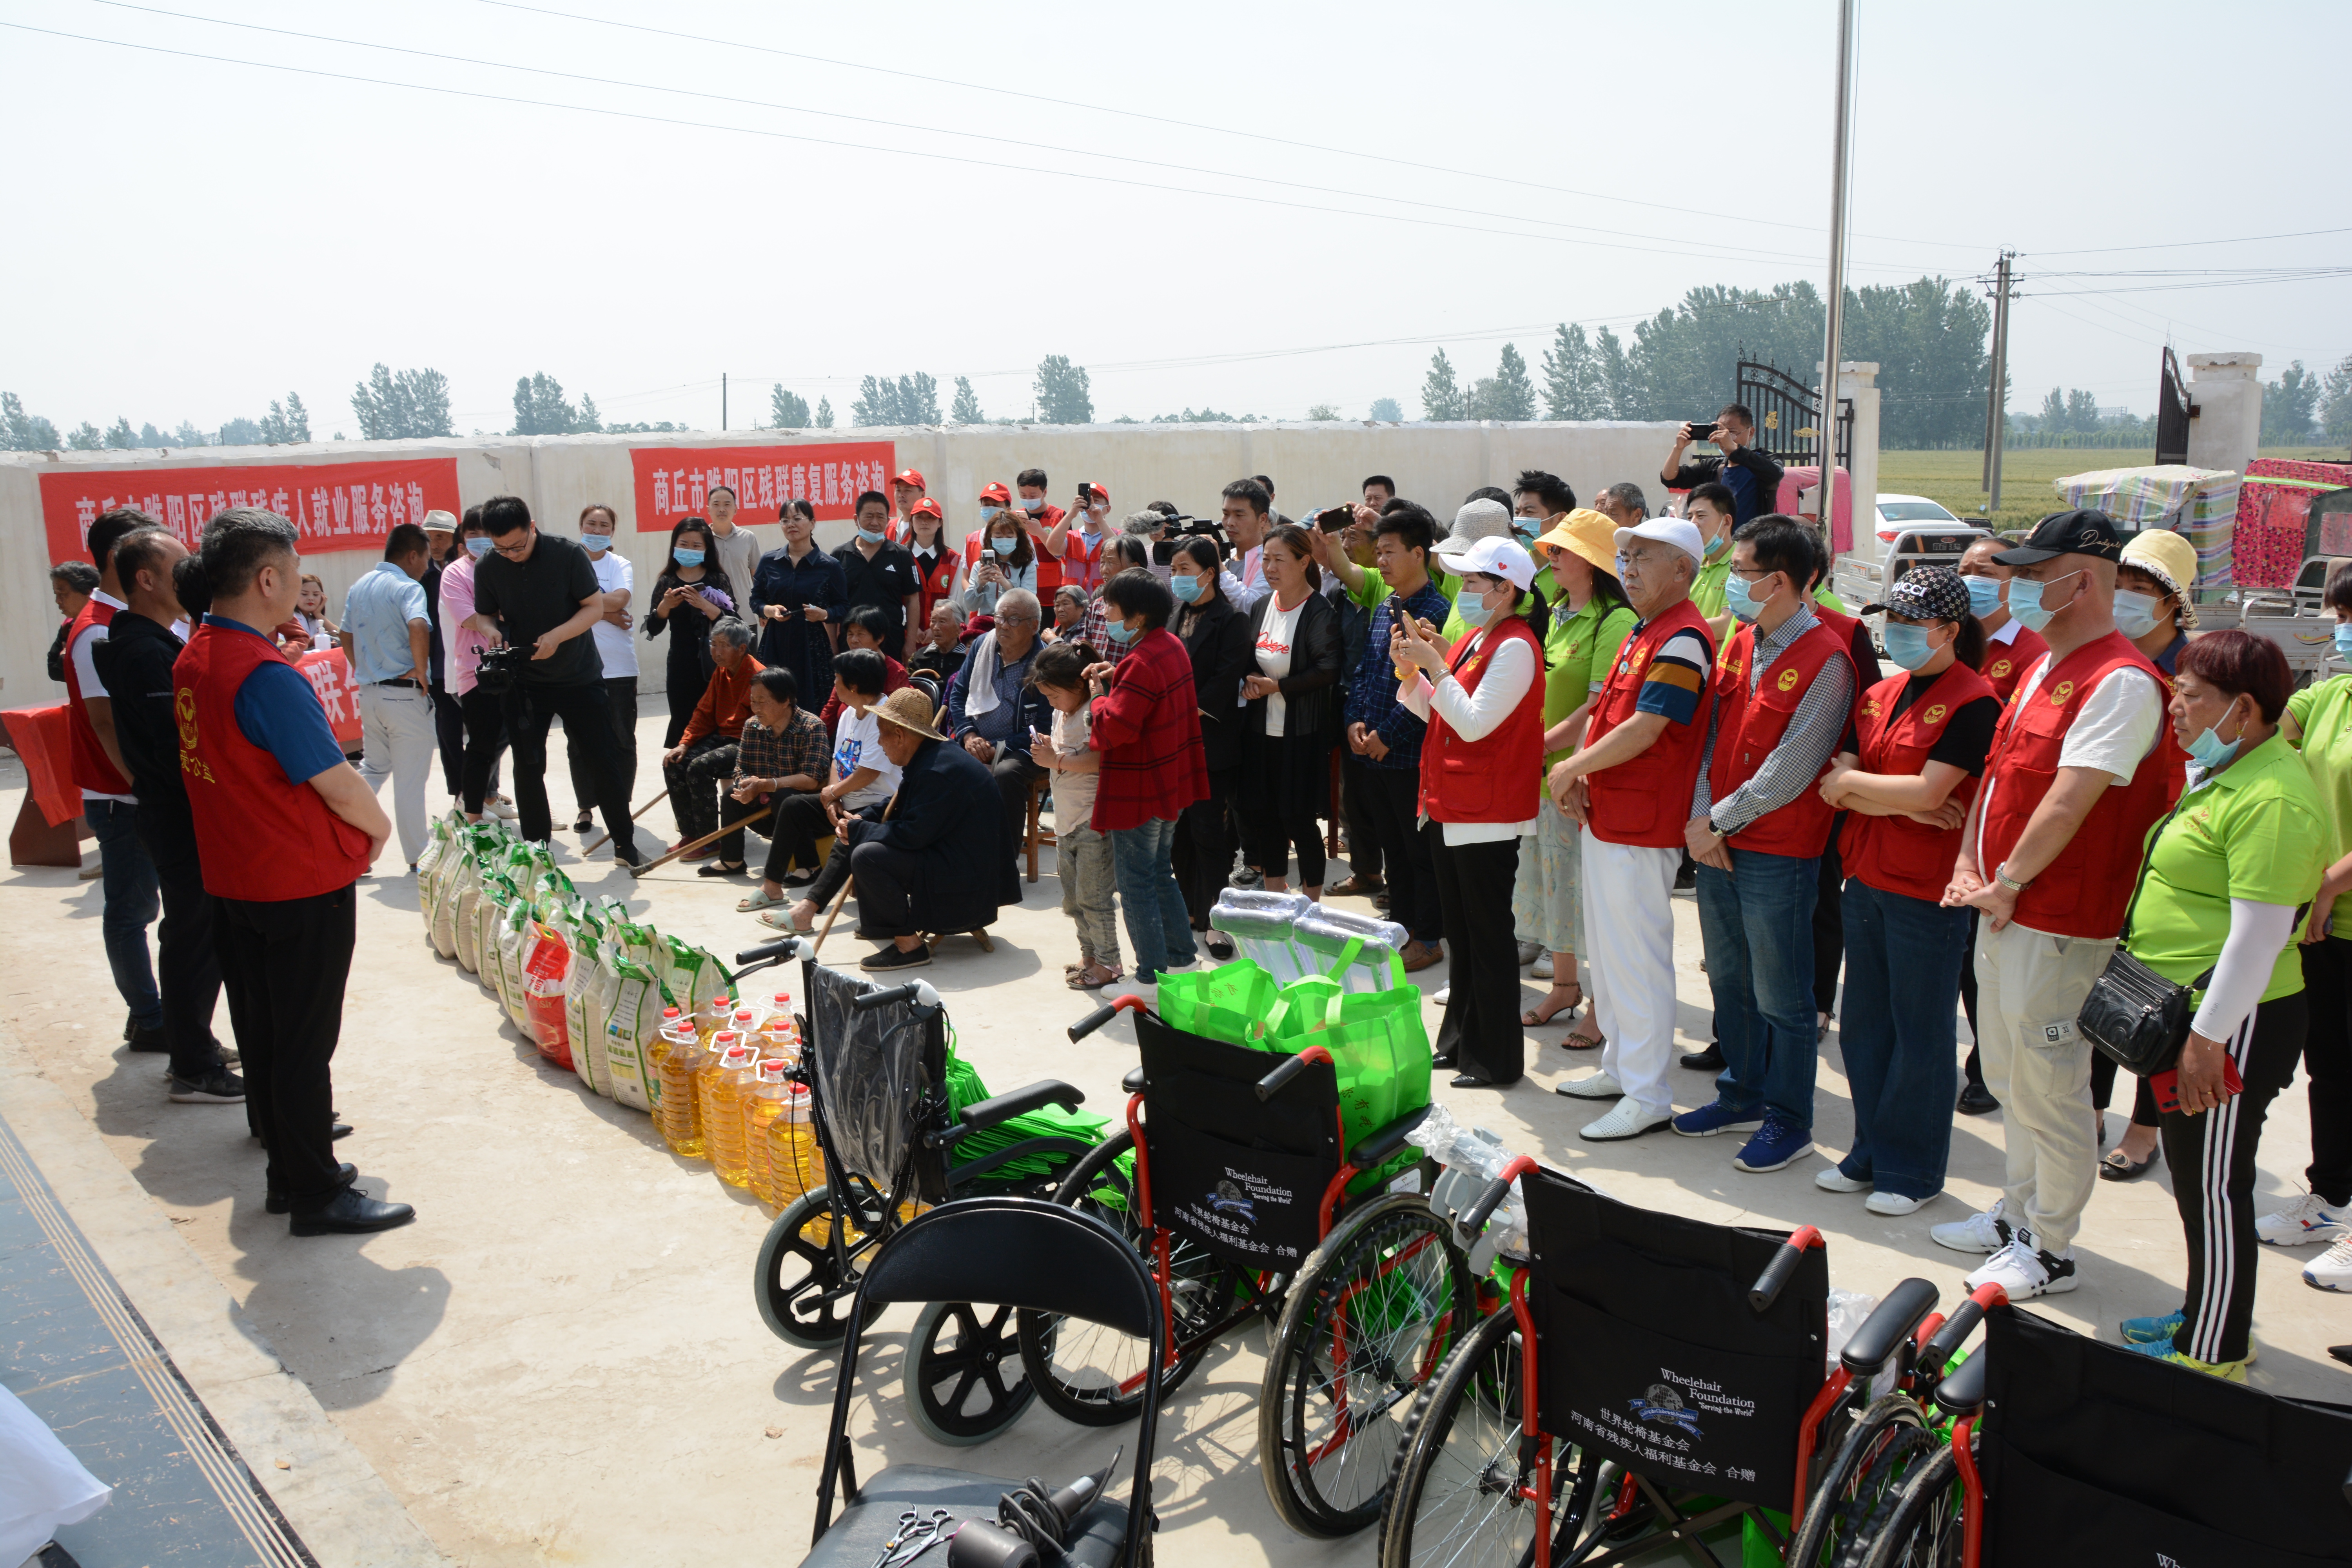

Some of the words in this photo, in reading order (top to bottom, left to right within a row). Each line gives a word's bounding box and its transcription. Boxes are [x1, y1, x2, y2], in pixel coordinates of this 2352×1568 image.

[75, 481, 425, 552] 商睢阳区疾人就业服务咨询
[1244, 1181, 1292, 1197] Foundation
[1174, 1206, 1270, 1254] 河南省残疾人福利基金会
[1275, 1245, 1298, 1258] 合赠
[1191, 1202, 1249, 1235] 世界轮椅基金会
[1689, 1387, 1755, 1408] Foundation
[1571, 1410, 1717, 1475] 河南省残疾人福利基金会
[1725, 1466, 1756, 1482] 合赠
[1600, 1407, 1691, 1452] 世界轮椅基金会
